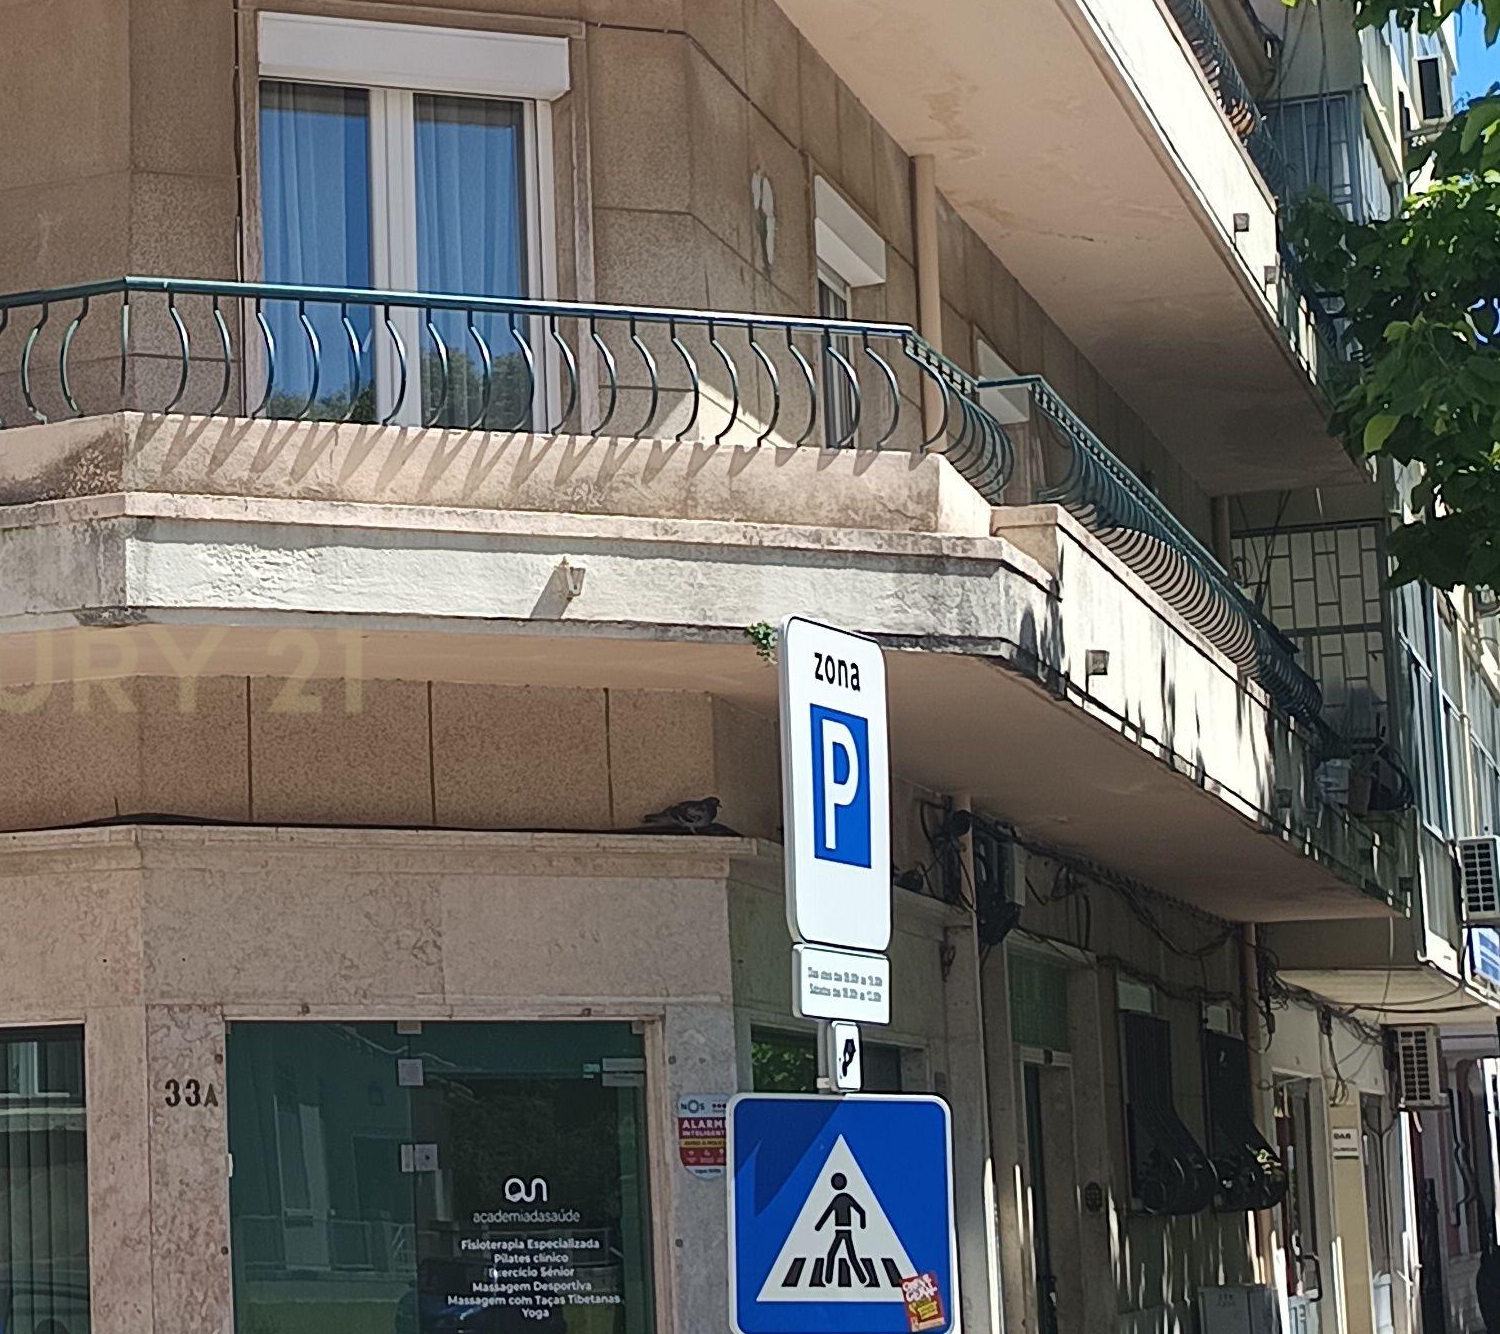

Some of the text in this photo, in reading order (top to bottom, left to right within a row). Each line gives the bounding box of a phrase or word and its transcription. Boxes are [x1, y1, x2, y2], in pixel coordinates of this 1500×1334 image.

[814, 651, 861, 692] zona
[821, 718, 859, 850] P
[165, 1078, 219, 1107] 33A
[680, 1099, 706, 1114] NOS
[682, 1119, 724, 1128] ALARM
[461, 1238, 600, 1251] Fisioterapia Especializada
[494, 1253, 531, 1264] Pilates
[489, 1267, 538, 1278] Eercício
[472, 1280, 592, 1294] Massagem Desportiva
[447, 1294, 621, 1308] Massagem com Taças Tibetanas
[521, 1308, 550, 1320] Yoga
